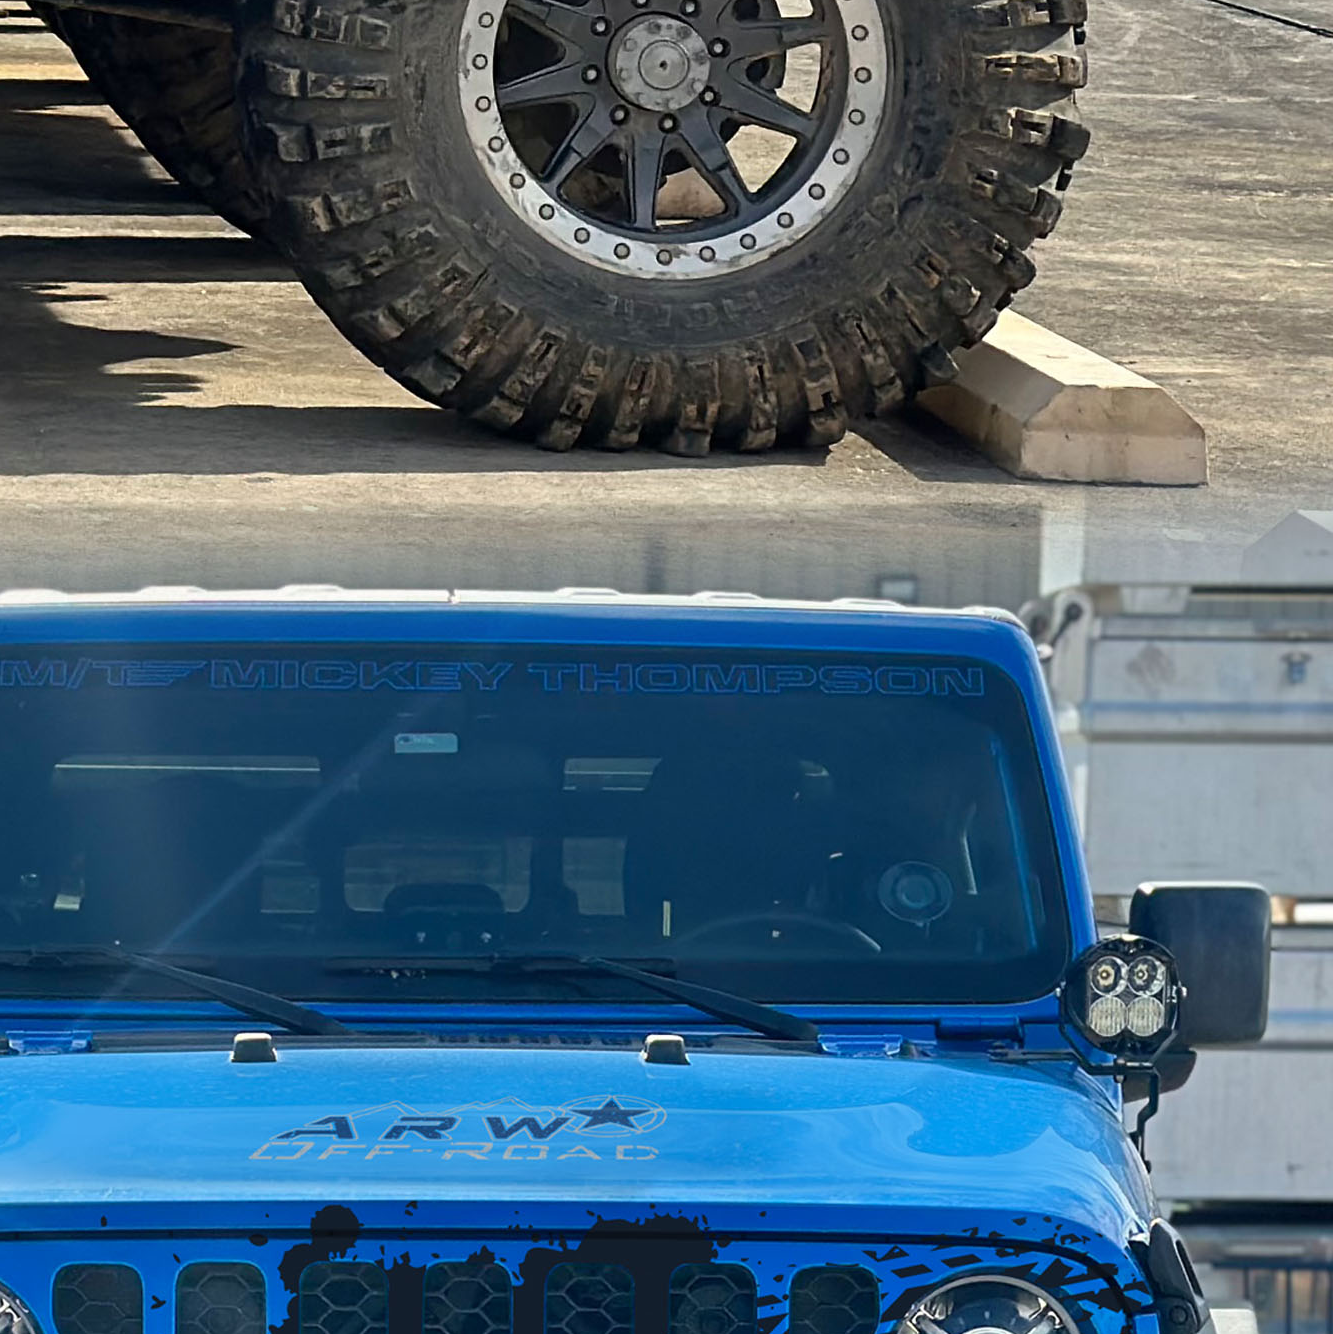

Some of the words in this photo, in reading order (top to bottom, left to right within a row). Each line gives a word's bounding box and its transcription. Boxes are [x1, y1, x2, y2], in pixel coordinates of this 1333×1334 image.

[210, 658, 513, 691] MICKEY
[528, 662, 985, 697] THOMPSON
[271, 1113, 573, 1141] ARW
[248, 1142, 661, 1161] OFF-ROAD
